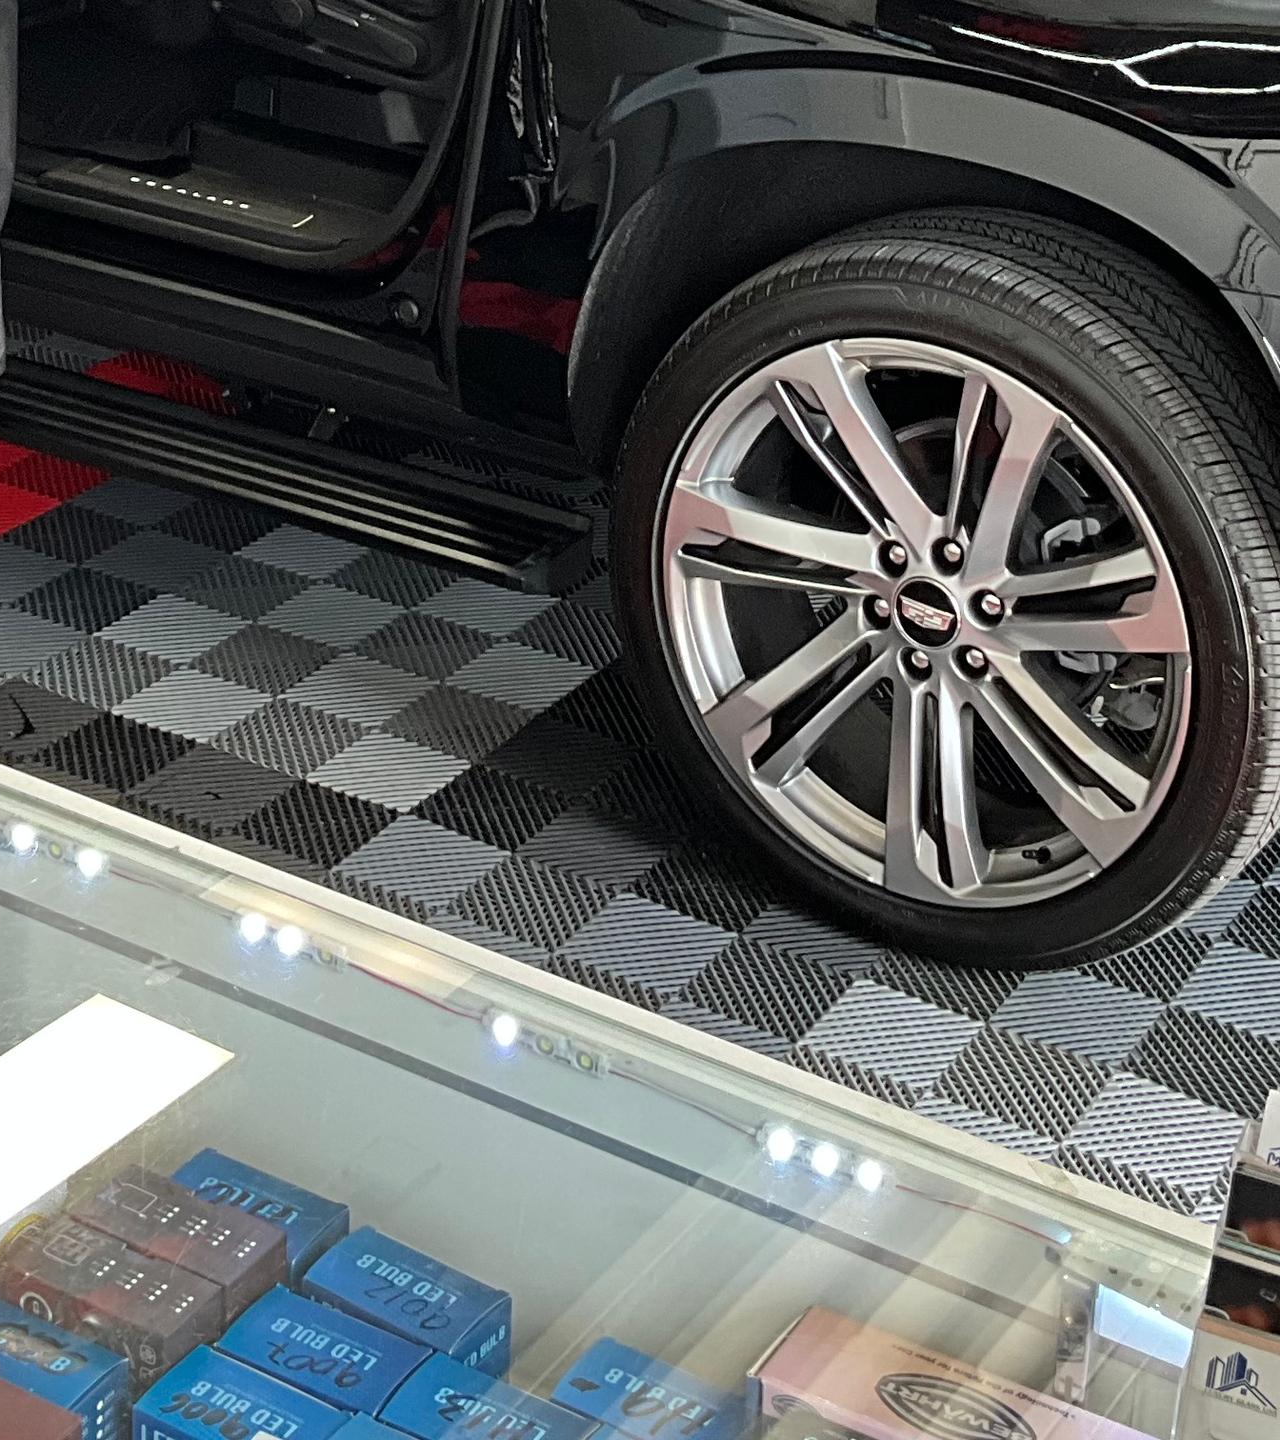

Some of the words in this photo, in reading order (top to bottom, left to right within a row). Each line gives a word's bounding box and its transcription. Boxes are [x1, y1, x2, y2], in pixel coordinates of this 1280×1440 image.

[356, 1254, 413, 1287] BULB
[413, 1280, 458, 1309] LED
[271, 1317, 329, 1351] BULB
[266, 1340, 364, 1389] 9007
[331, 1343, 379, 1372] LED
[190, 1380, 251, 1414] BULB
[250, 1409, 299, 1439] LED
